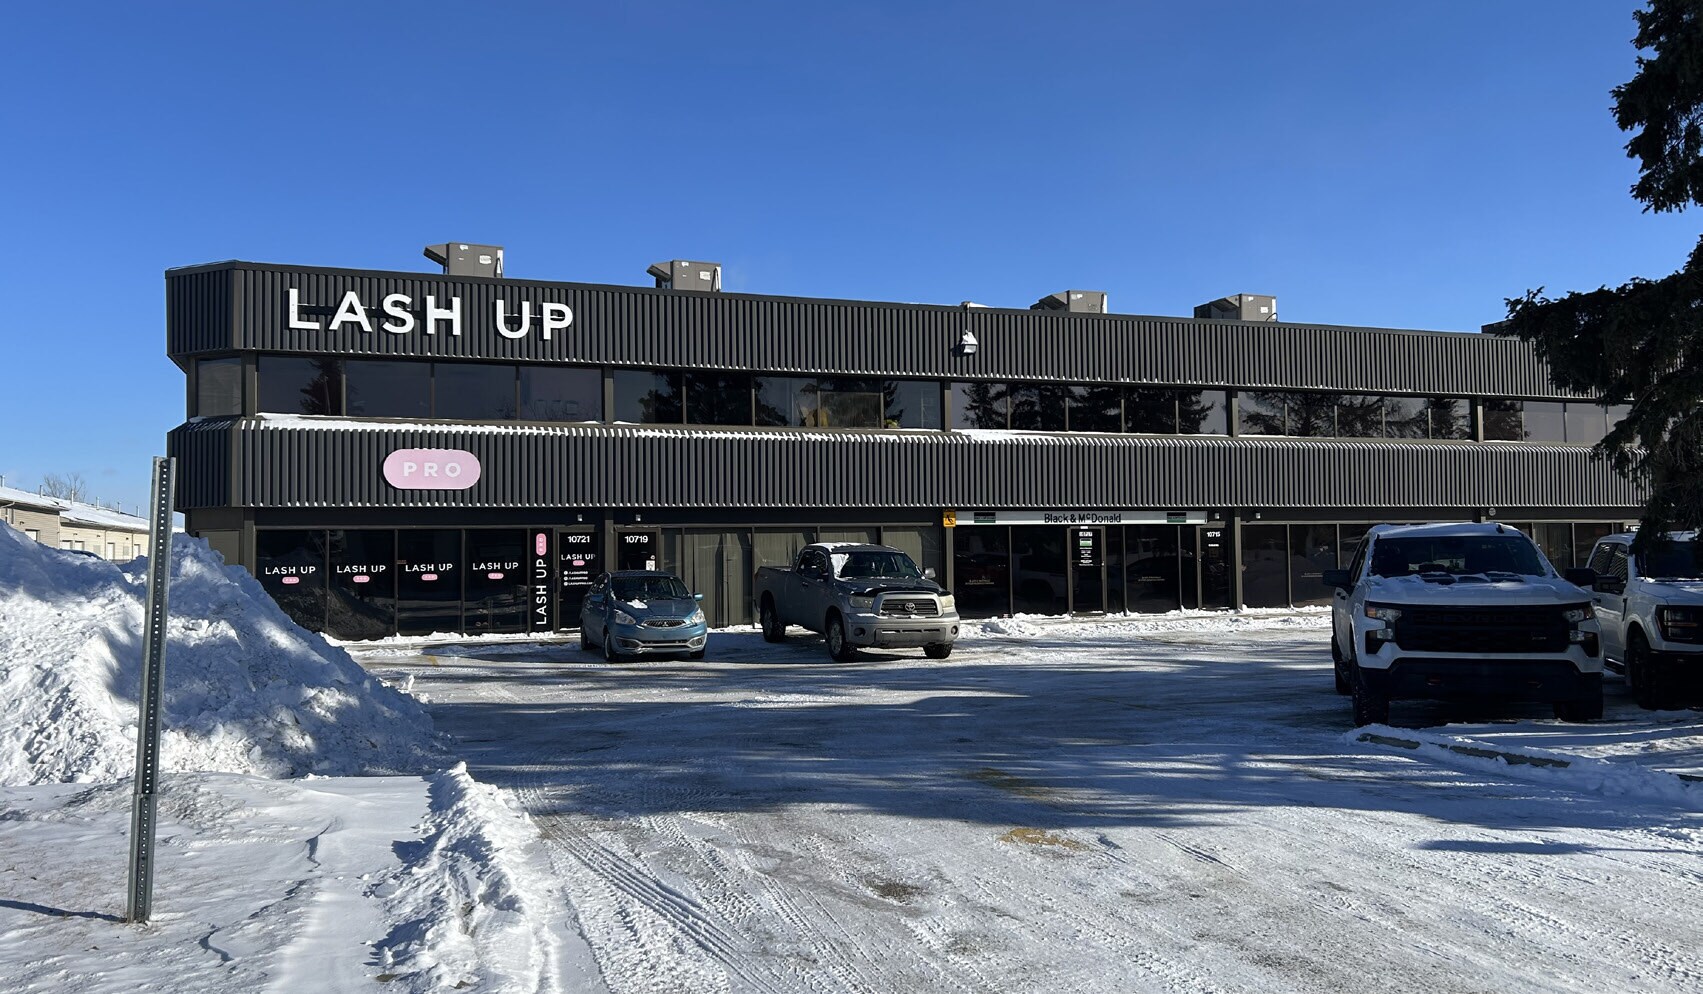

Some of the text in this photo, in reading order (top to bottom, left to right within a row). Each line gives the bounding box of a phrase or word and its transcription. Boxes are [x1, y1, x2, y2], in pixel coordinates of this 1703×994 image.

[288, 288, 574, 340] LASH UP
[403, 461, 462, 478] PRO
[1044, 513, 1122, 523] Black & McDonald
[567, 535, 591, 543] 10721
[624, 535, 649, 543] 10719
[265, 566, 316, 575] LASH UP
[336, 565, 387, 574] LASH UP
[405, 563, 453, 572] LASH UP
[473, 562, 519, 571] LASH UP
[536, 559, 547, 625] LASH UP
